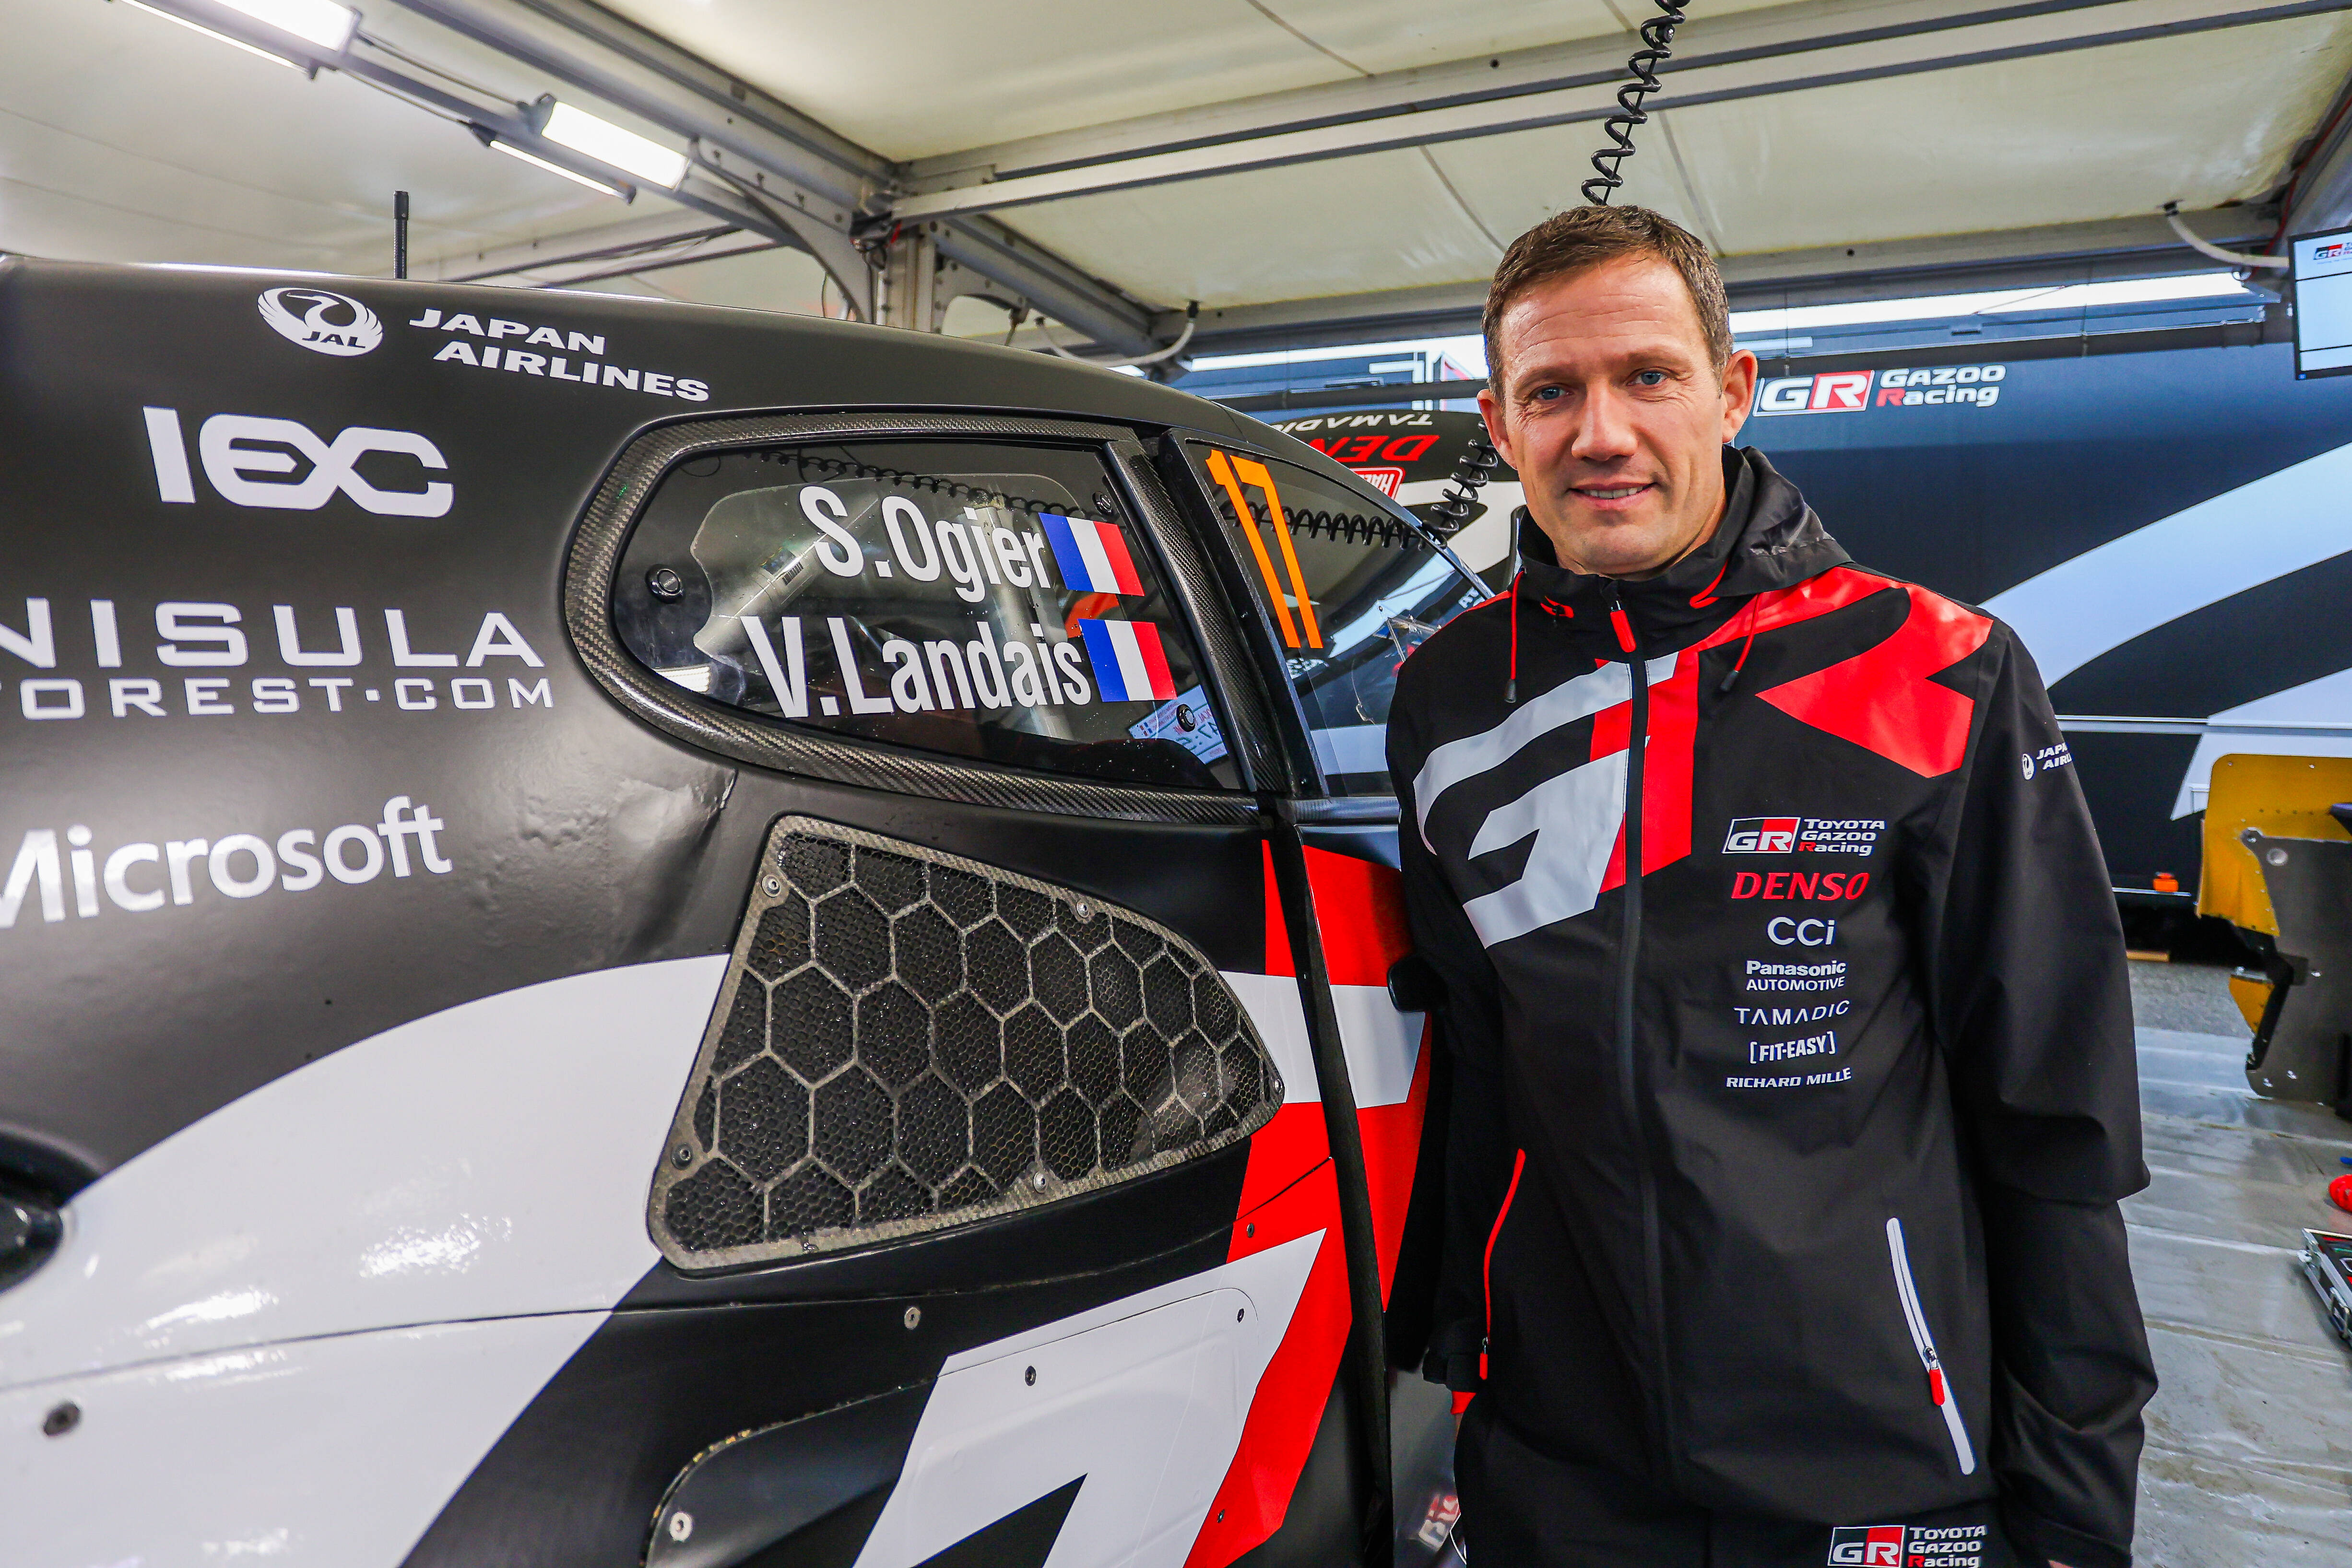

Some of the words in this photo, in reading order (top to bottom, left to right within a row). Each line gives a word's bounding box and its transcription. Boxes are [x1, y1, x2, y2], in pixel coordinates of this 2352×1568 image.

[301, 328, 366, 350] JAL
[410, 308, 606, 355] JAPAN
[433, 340, 710, 402] AIRLINES
[1879, 364, 2006, 388] GAZOO
[1760, 374, 1869, 412] GR
[1876, 385, 2000, 408] Racing
[798, 485, 1052, 603] S.Ogier
[1205, 448, 1324, 649] 17
[740, 615, 1092, 718] V.Landais
[1800, 830, 1876, 841] GAZOO
[1803, 818, 1885, 830] TOYOTA
[1727, 831, 1793, 851] GR
[1798, 841, 1873, 856] Racing
[1730, 872, 1869, 900] DENSO
[1767, 916, 1835, 946] CCi
[1746, 960, 1846, 976] Panasonic
[1746, 976, 1845, 991] AUTOMOTIVE
[1734, 1000, 1850, 1026] TAMADIC
[1726, 1076, 1801, 1088] RICHARD
[1806, 1067, 1852, 1085] MILLE
[1908, 1524, 1987, 1541] TOYOTA
[1832, 1542, 1899, 1566] GR
[1908, 1540, 1982, 1555] GAZOO
[1907, 1554, 1981, 1568] Racing
